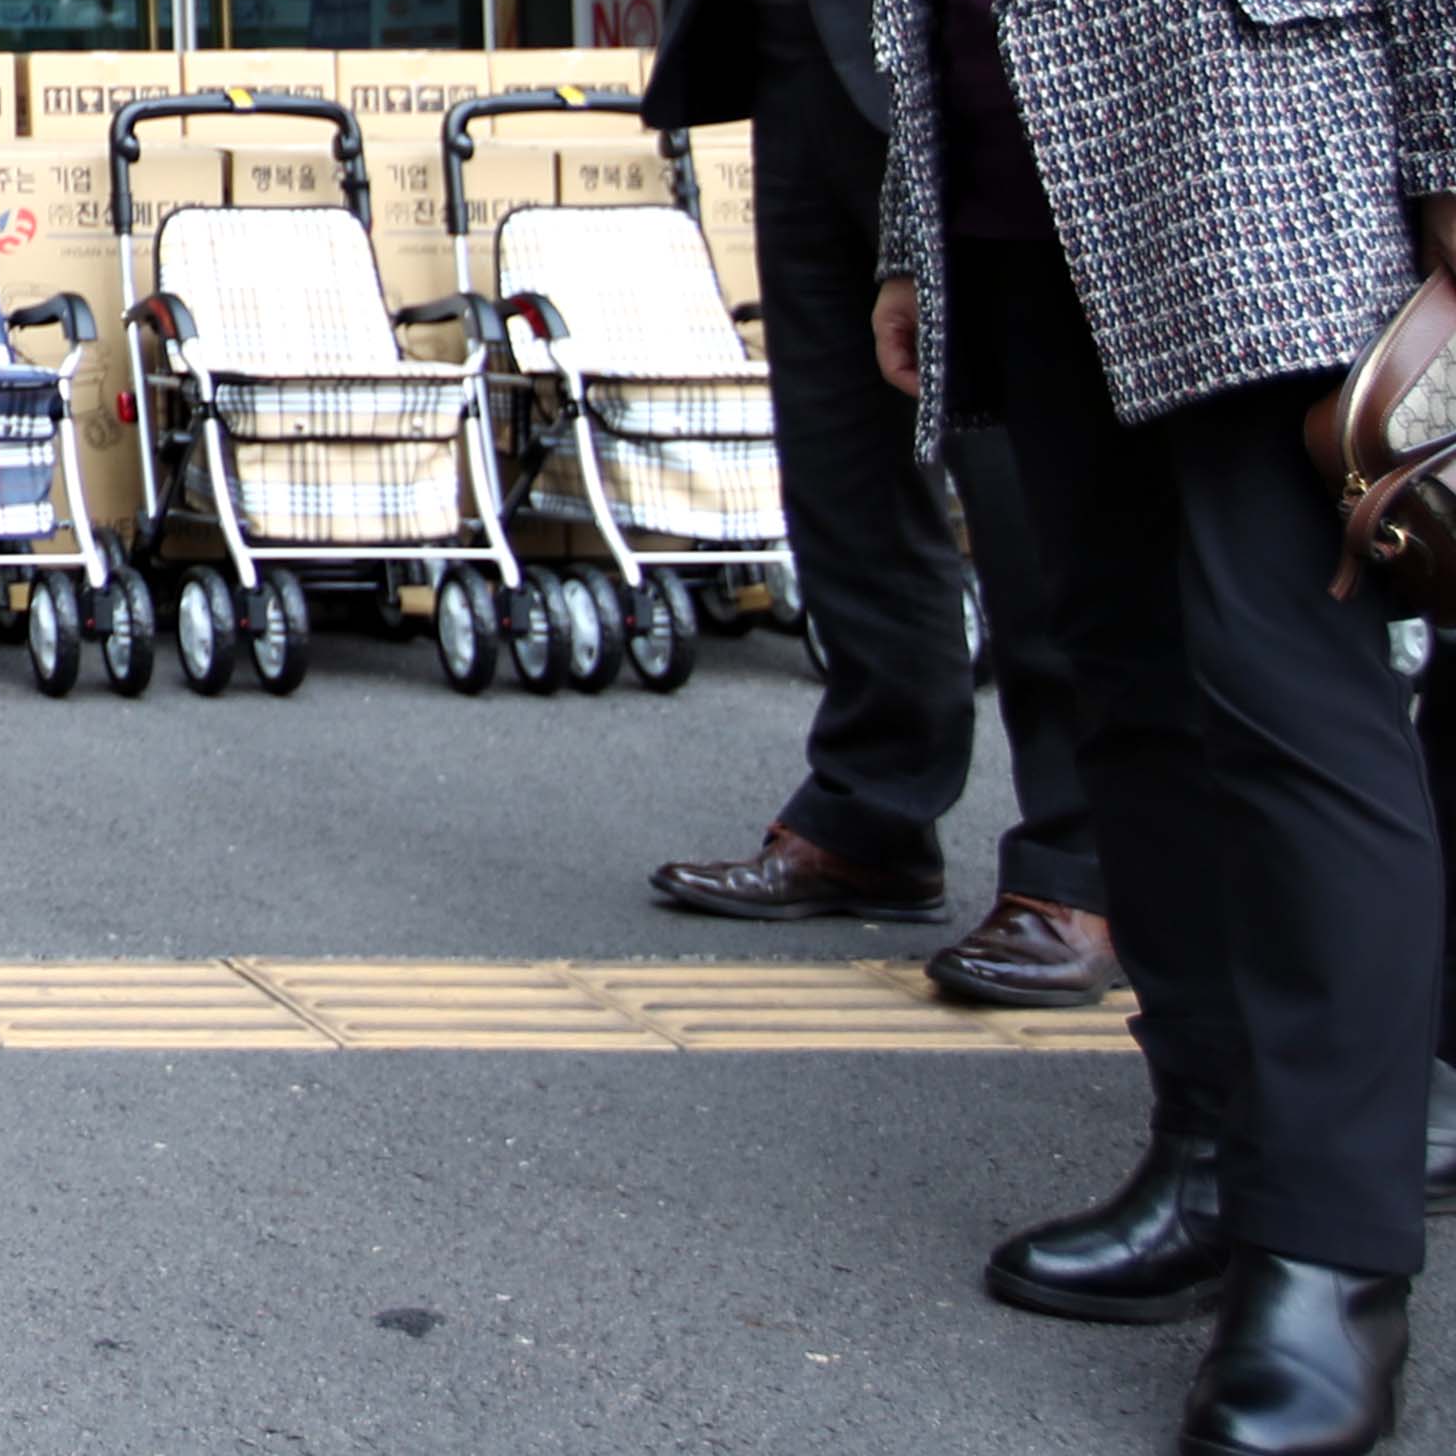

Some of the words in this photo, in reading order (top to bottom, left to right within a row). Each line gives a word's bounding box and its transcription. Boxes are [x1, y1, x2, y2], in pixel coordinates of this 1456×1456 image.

[50, 167, 92, 192] 기업
[251, 164, 317, 191] 행복을
[387, 164, 429, 190] 기업
[579, 162, 644, 191] 행복을
